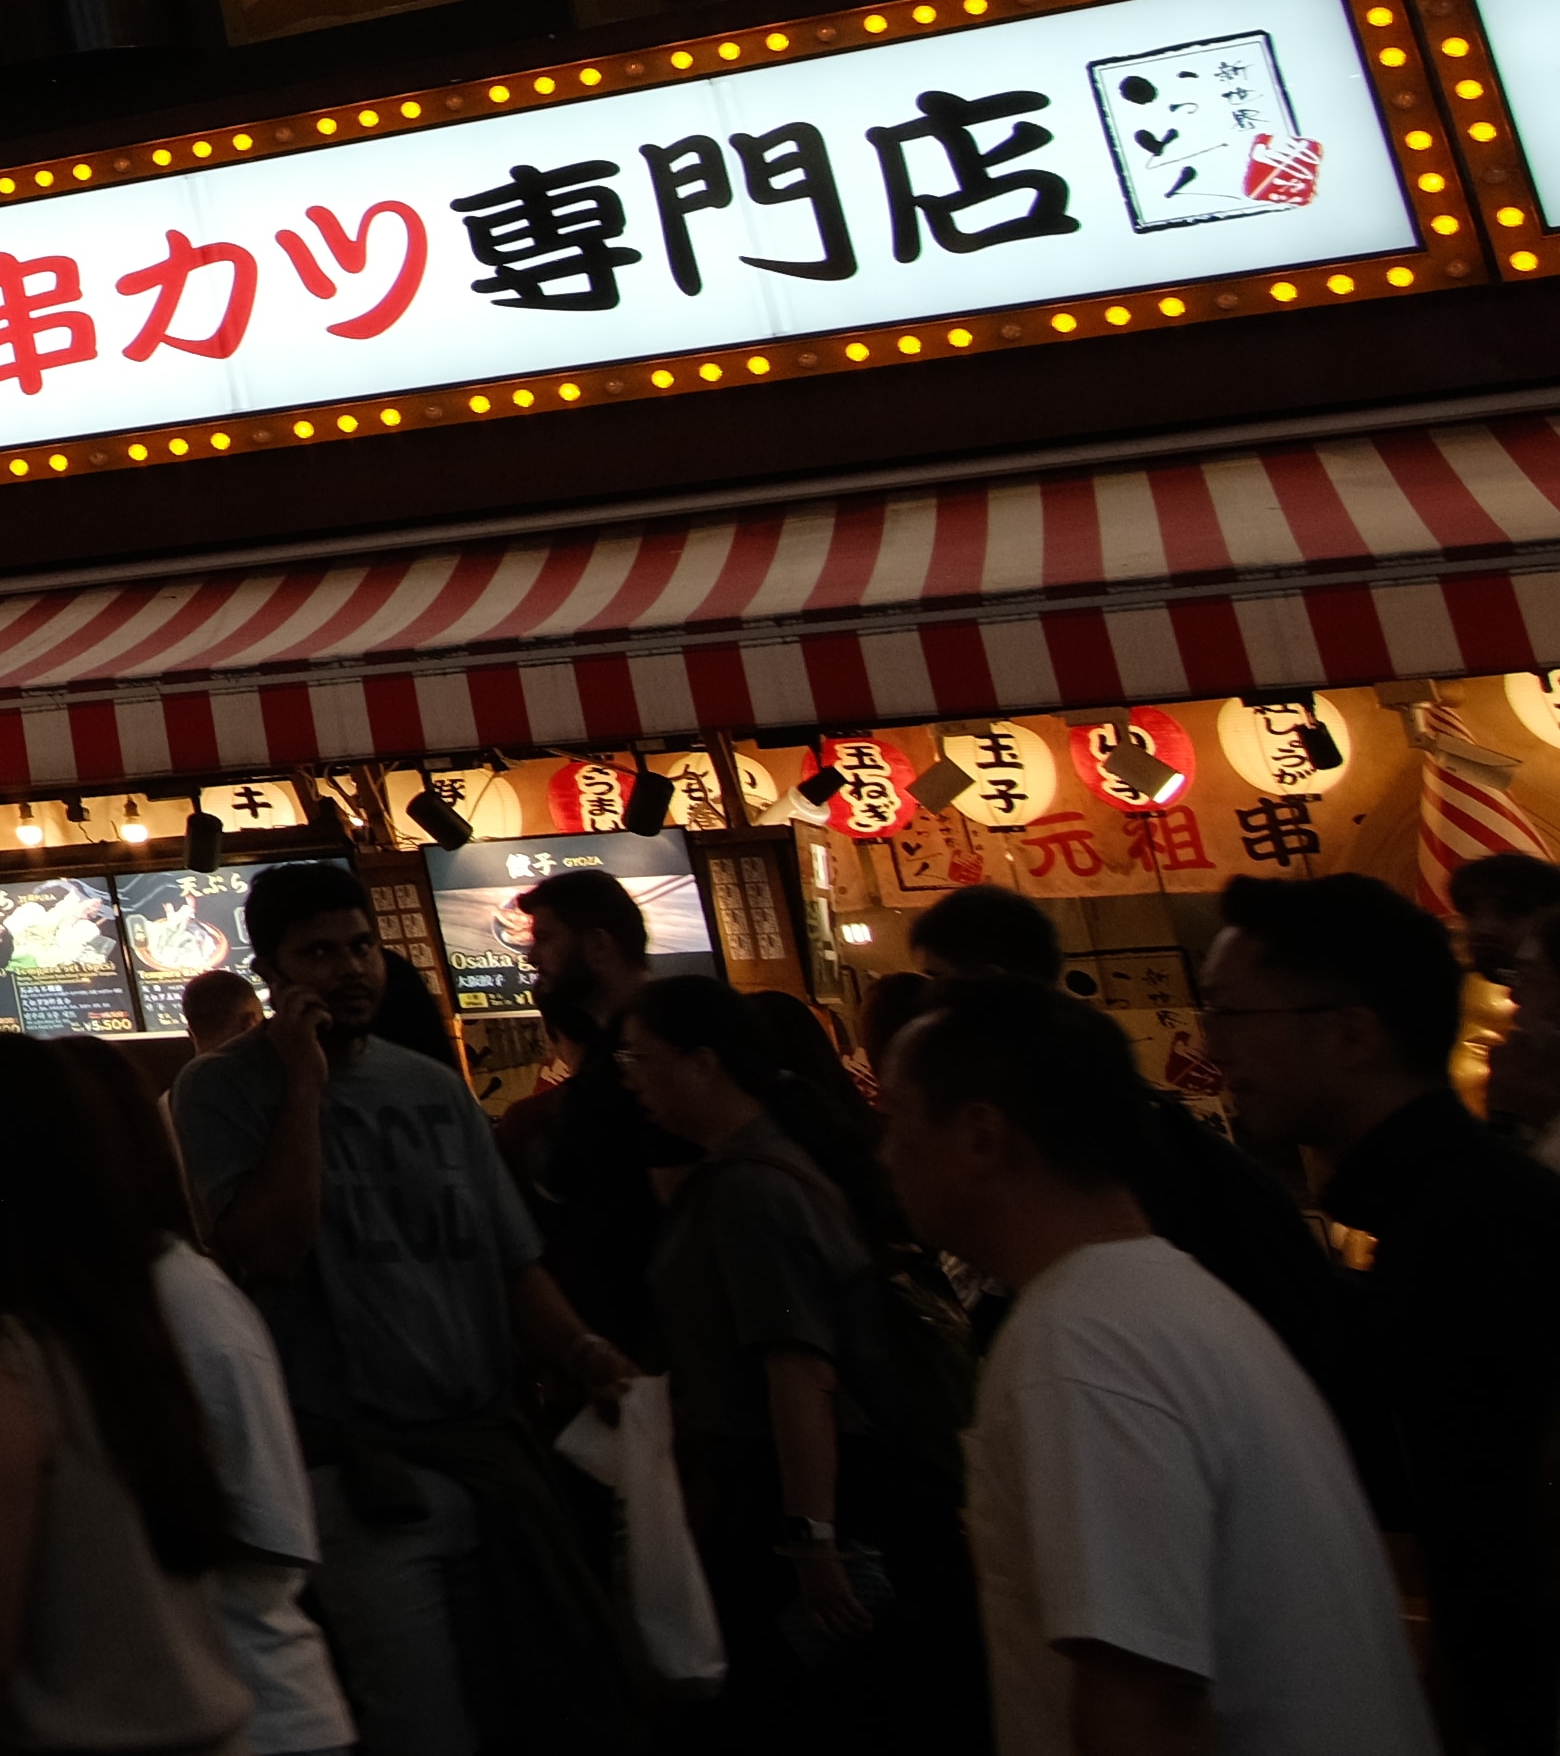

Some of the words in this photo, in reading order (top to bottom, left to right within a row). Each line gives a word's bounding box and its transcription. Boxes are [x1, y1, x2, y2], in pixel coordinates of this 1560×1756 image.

[836, 740, 894, 833] 玉ねぎ
[978, 732, 1028, 814] 玉子
[505, 852, 558, 879] 餃子
[563, 856, 604, 868] GYOZA
[174, 872, 250, 899] 天ぷら
[451, 949, 513, 973] Osaka
